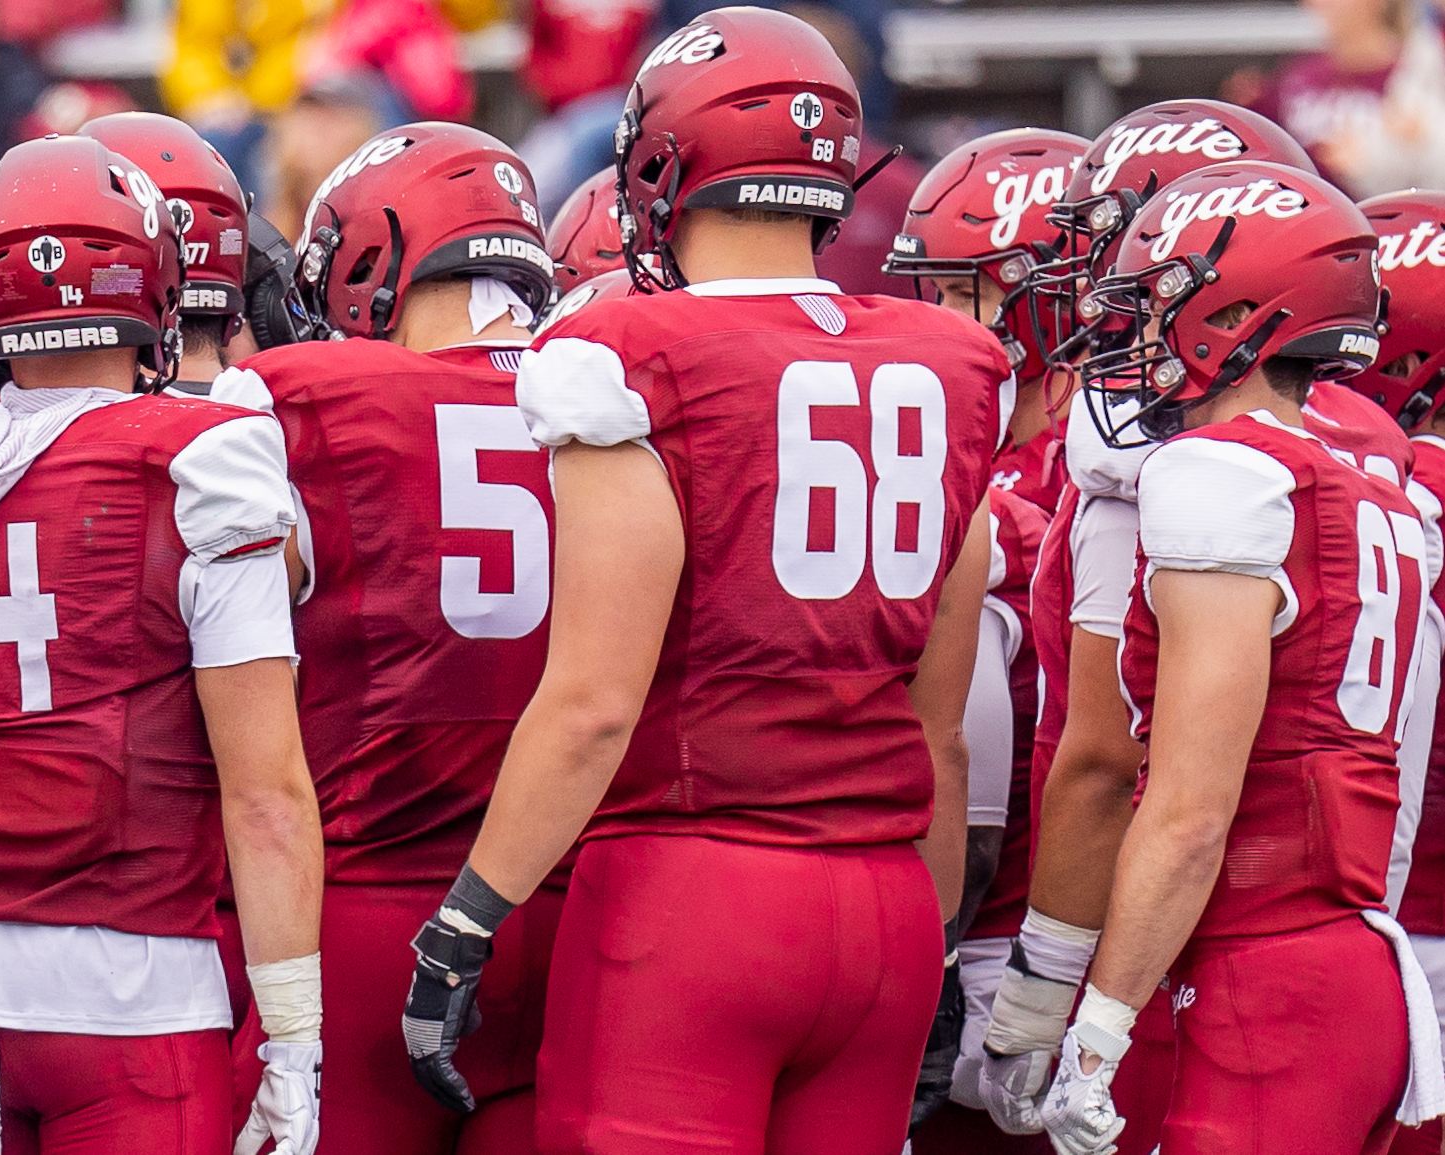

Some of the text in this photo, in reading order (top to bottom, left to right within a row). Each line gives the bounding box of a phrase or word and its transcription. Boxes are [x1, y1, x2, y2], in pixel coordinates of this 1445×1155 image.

[812, 138, 835, 163] 68
[738, 184, 845, 211] RAIDERS
[186, 243, 210, 265] 77
[468, 237, 554, 278] RAIDER
[59, 285, 84, 306] 14
[1, 326, 119, 353] RAIDERS
[772, 361, 947, 600] 68
[1336, 500, 1430, 743] 87
